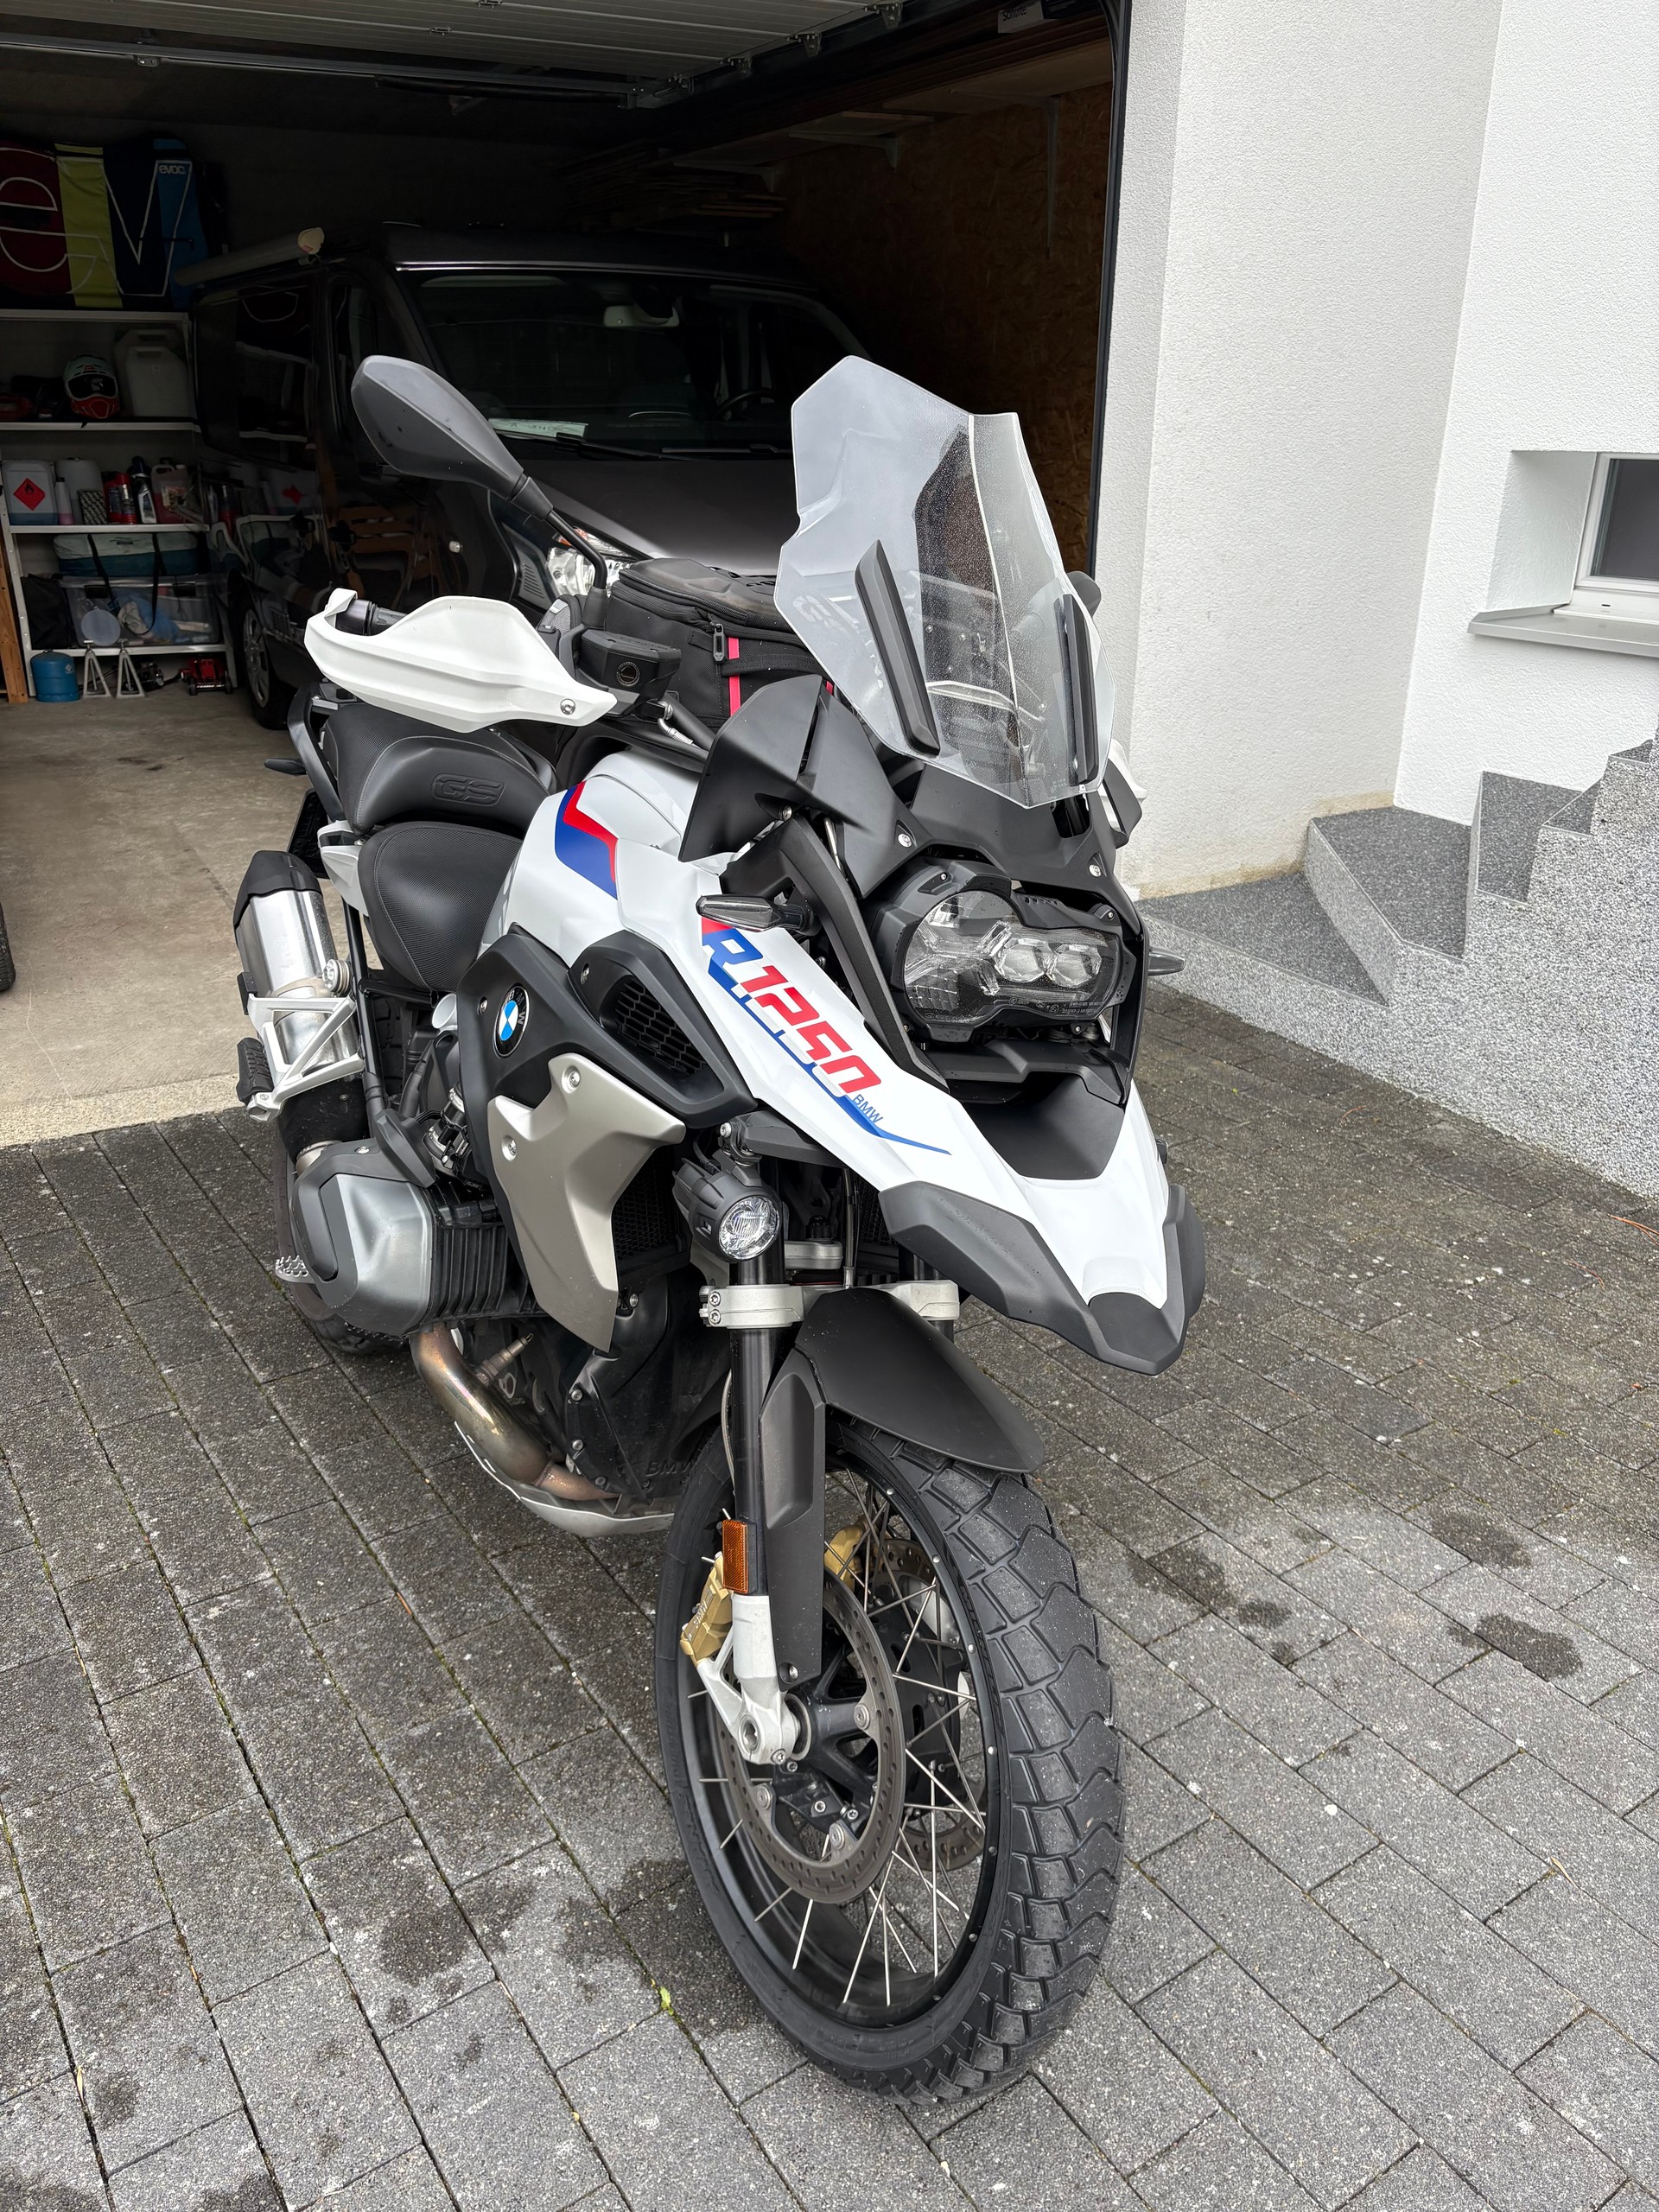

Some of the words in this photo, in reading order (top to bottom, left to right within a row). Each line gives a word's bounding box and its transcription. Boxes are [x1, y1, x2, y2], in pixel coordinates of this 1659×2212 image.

[158, 163, 187, 175] evoc
[434, 776, 502, 806] GS
[852, 1092, 884, 1123] BMW
